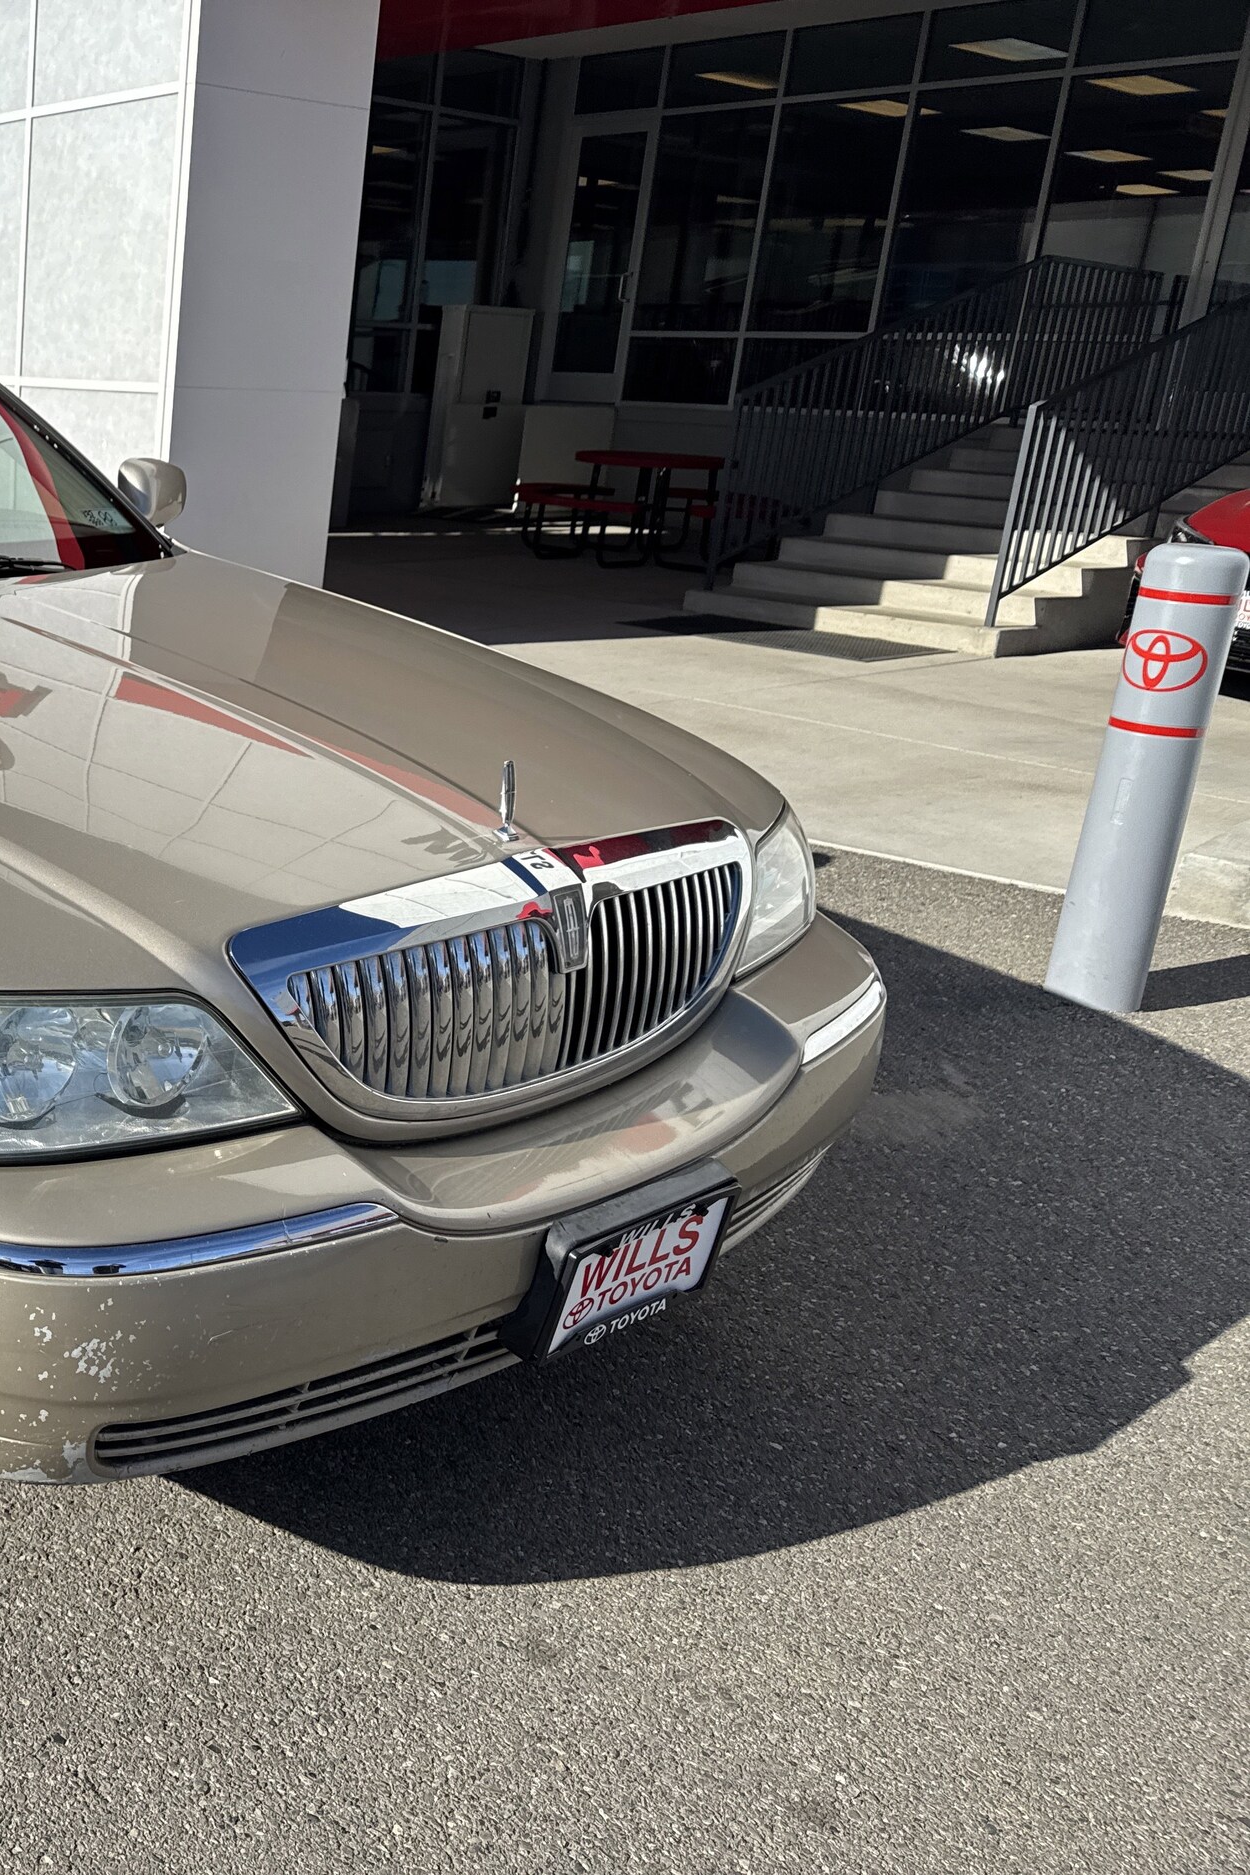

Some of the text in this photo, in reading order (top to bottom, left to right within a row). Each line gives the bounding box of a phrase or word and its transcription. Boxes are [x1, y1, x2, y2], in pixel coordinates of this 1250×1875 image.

[619, 1203, 696, 1248] WILLS
[581, 1215, 703, 1298] WILLS
[597, 1256, 691, 1312] TOYOTA
[609, 1298, 667, 1334] TOYOTA
